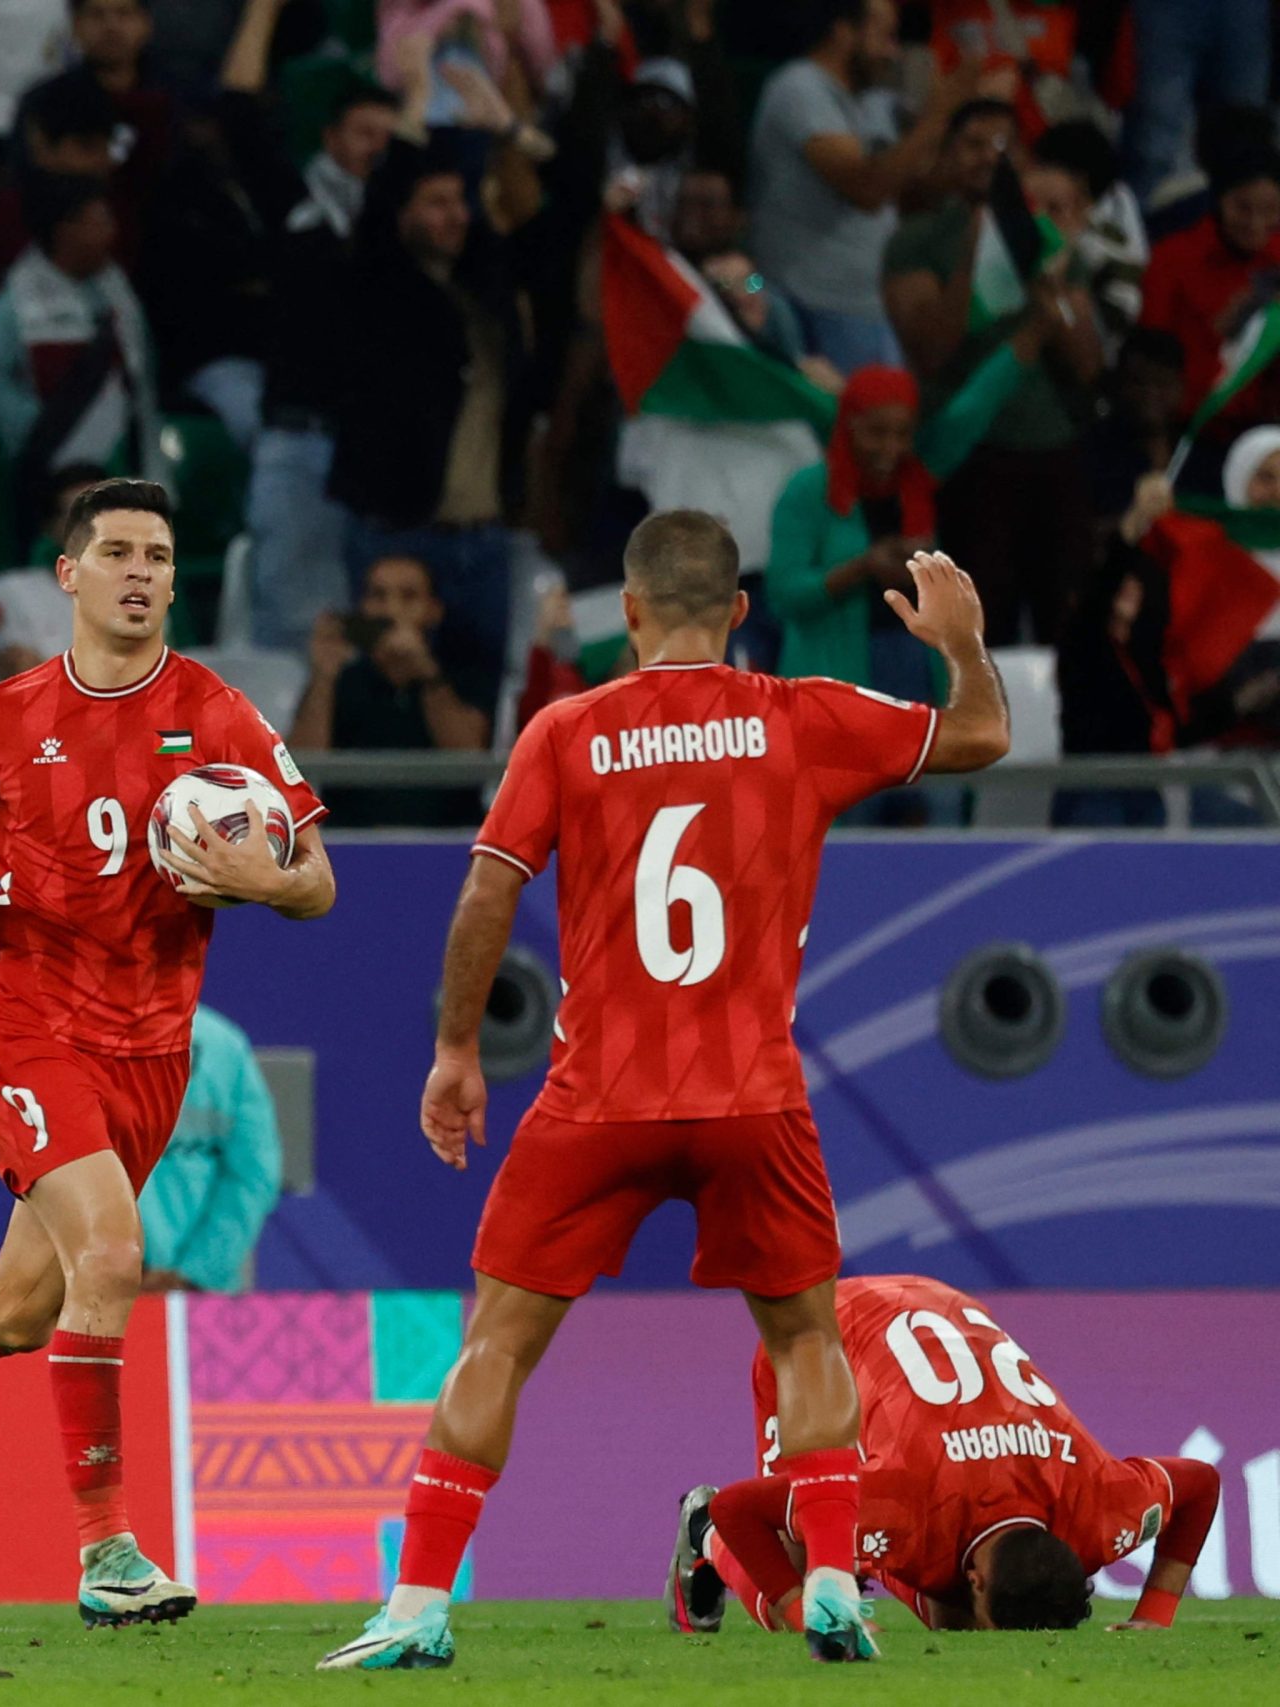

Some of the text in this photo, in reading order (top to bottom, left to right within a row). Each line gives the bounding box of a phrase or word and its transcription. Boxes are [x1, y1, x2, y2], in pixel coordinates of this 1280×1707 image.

[33, 755, 67, 764] KELME
[590, 716, 767, 775] O.KHAROUB
[87, 796, 128, 876] 9
[634, 803, 726, 986] 6
[1, 1085, 49, 1153] 9
[885, 1306, 1061, 1407] 20
[762, 1416, 782, 1478] 2
[941, 1418, 1077, 1464] Z.QUNBAR
